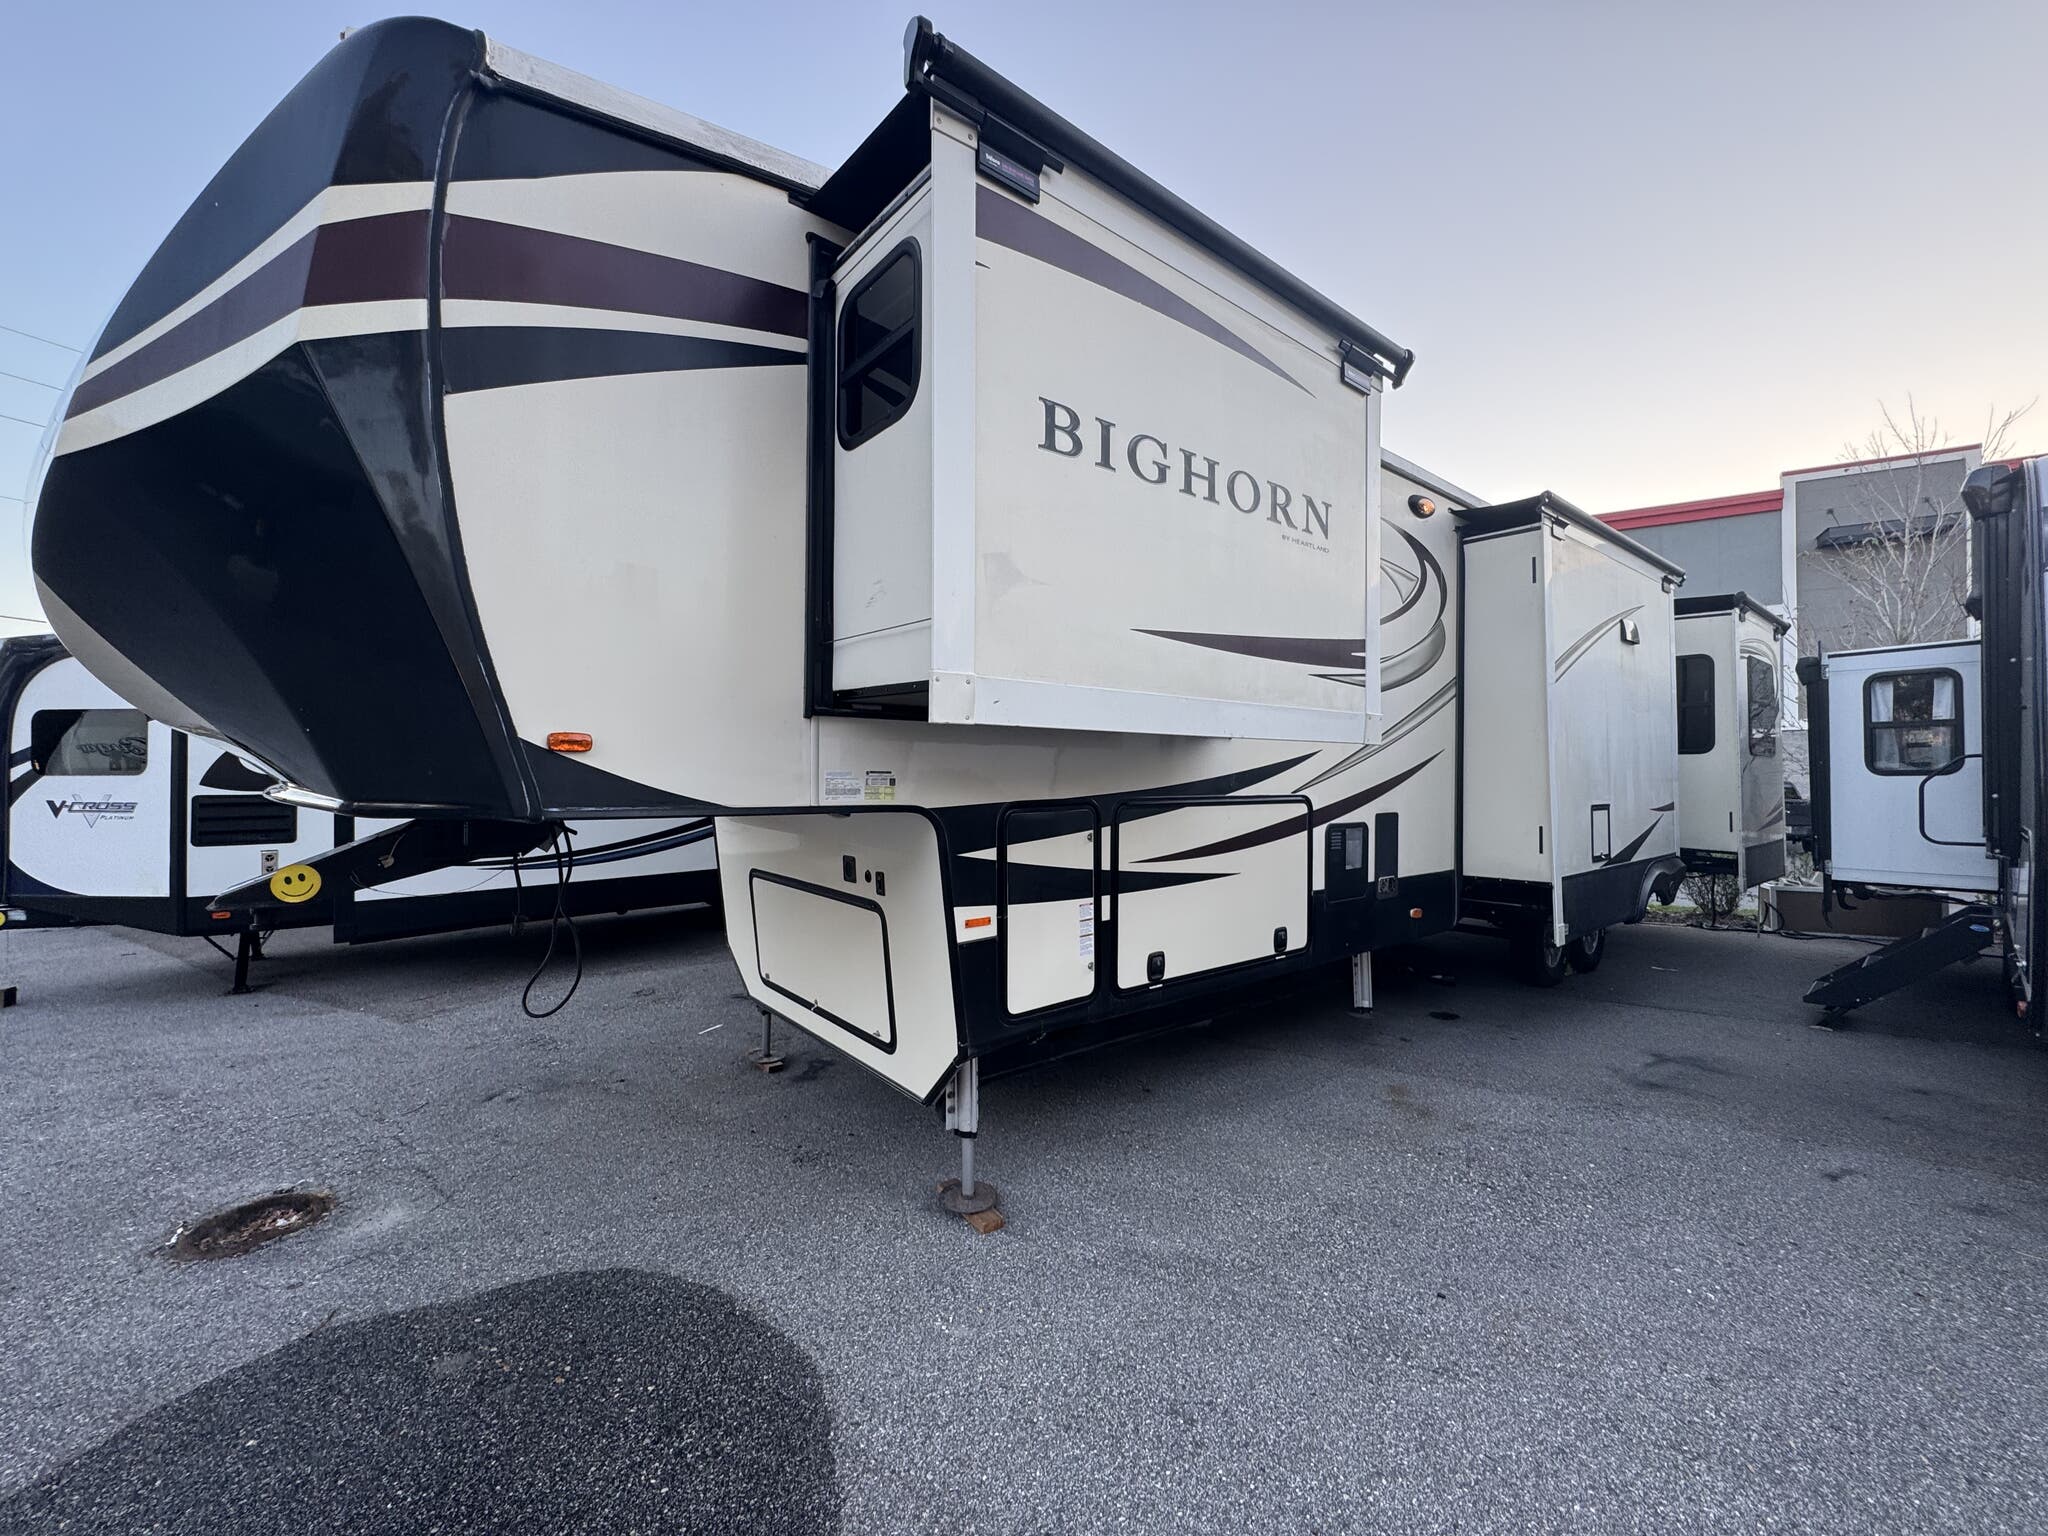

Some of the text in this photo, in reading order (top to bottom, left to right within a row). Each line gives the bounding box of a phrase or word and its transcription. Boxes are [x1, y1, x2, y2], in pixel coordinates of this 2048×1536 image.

[1038, 396, 1332, 540] BIGHORN
[1291, 536, 1330, 553] HEARTLAND
[46, 800, 138, 819] V-CROSS
